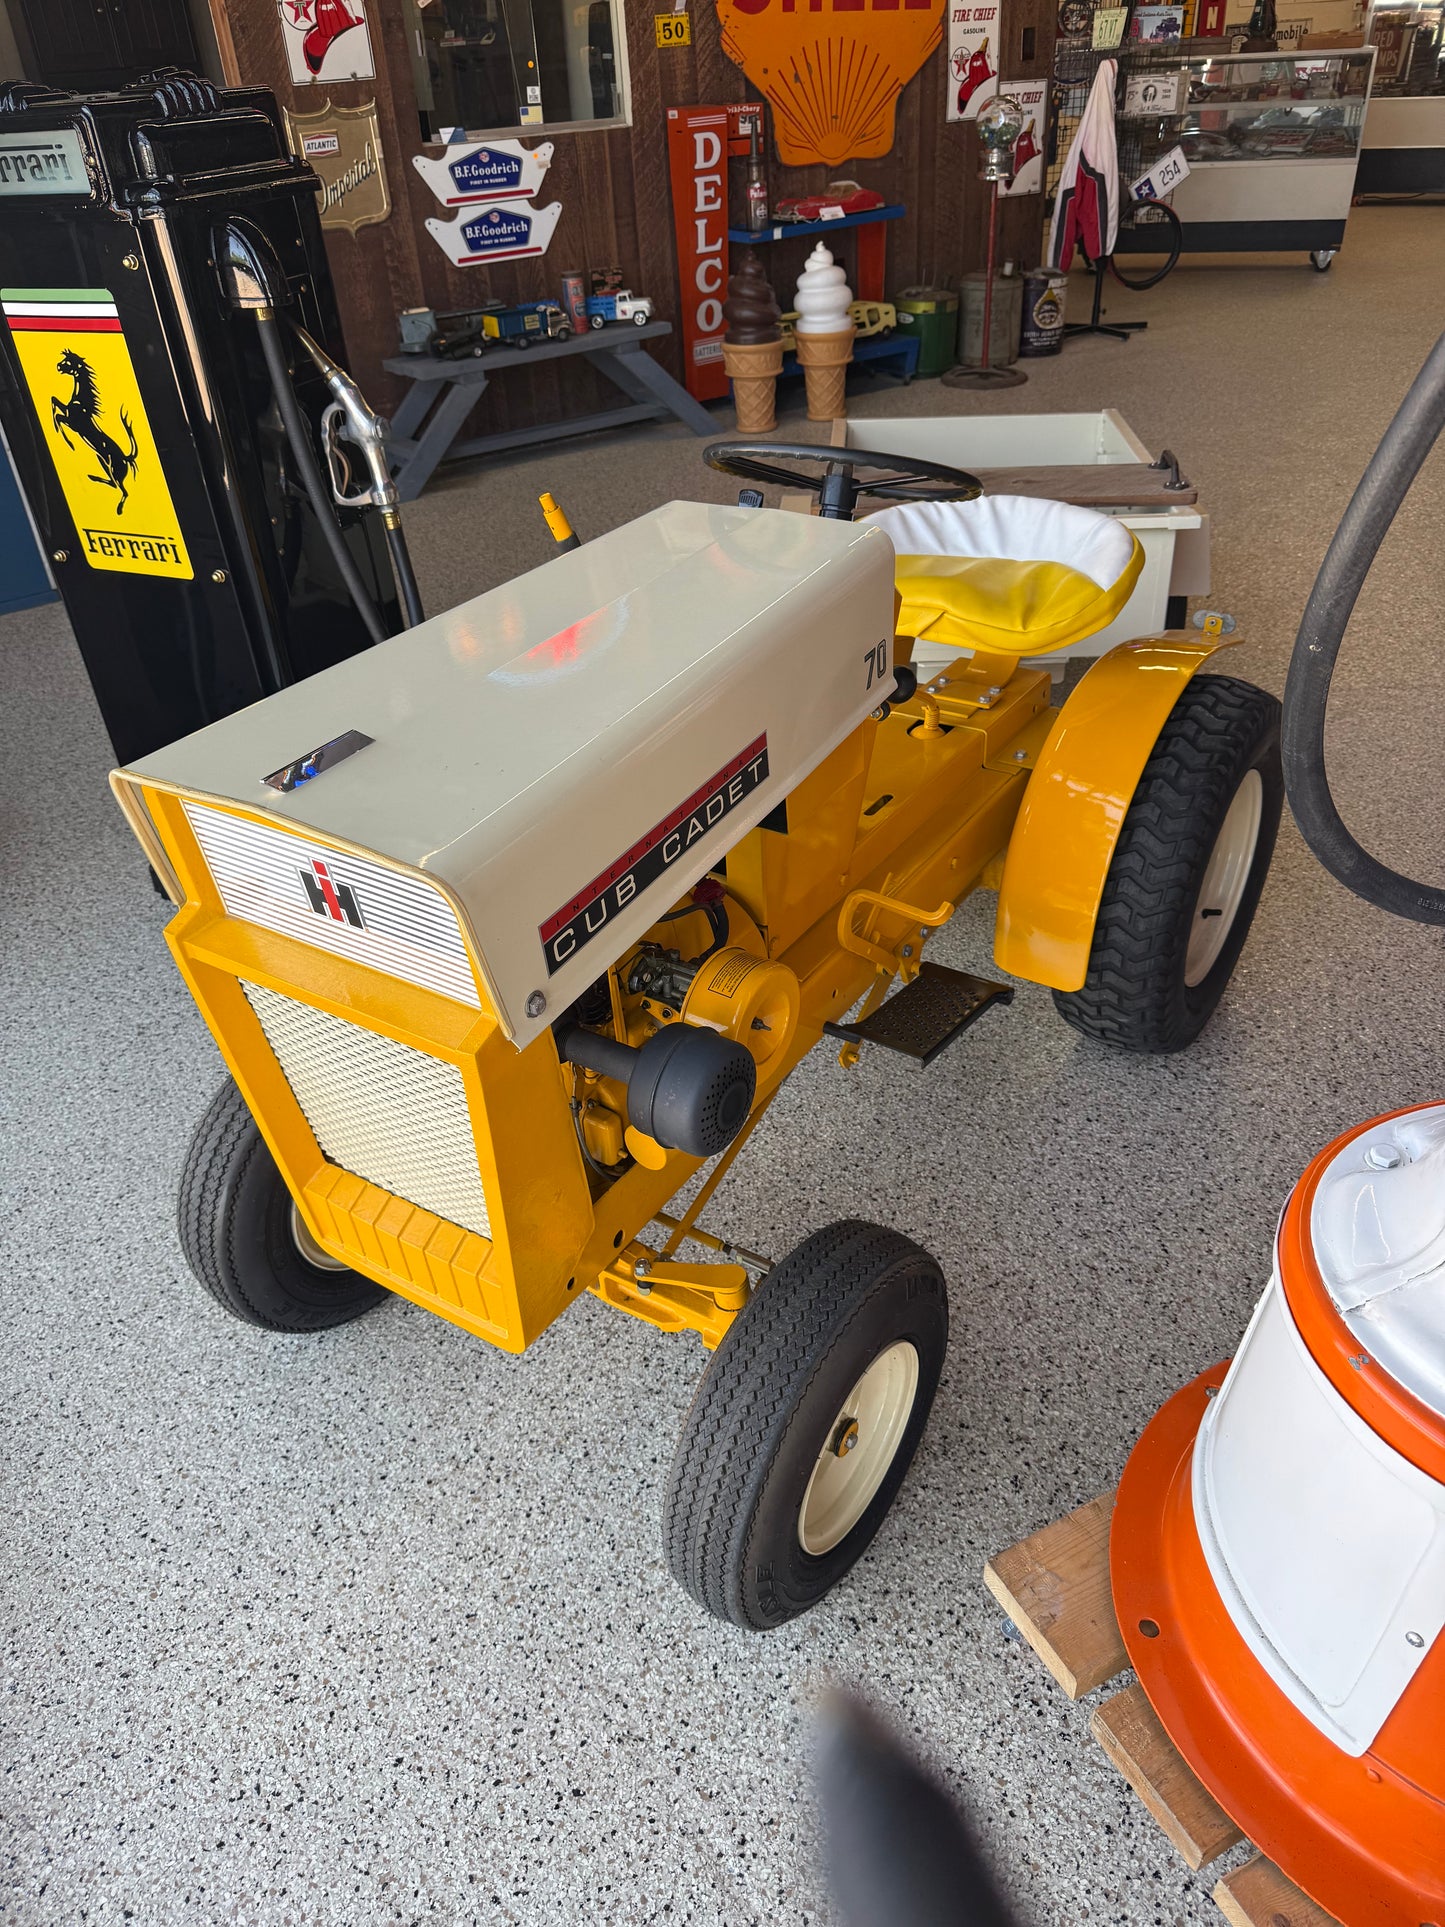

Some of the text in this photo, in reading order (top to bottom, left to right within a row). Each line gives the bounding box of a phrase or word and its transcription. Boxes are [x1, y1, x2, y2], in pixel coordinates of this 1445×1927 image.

[952, 7, 998, 23] FIRE CHIEF
[662, 20, 684, 40] 50
[963, 27, 986, 35] GASOLINE
[1021, 90, 1044, 105] CHIEF
[305, 139, 338, 152] ATLANTIC
[0, 142, 74, 184] rrari
[453, 161, 520, 179] B.F.Goodrich
[1159, 159, 1181, 186] 254
[318, 142, 377, 215] Imperial
[465, 220, 529, 239] B.F.Goodrich
[693, 130, 724, 333] DELCO
[82, 527, 182, 565] Ferrari
[863, 638, 887, 691] 70
[554, 745, 758, 927] INTERNATIONAL
[553, 757, 764, 963] CUB CADET
